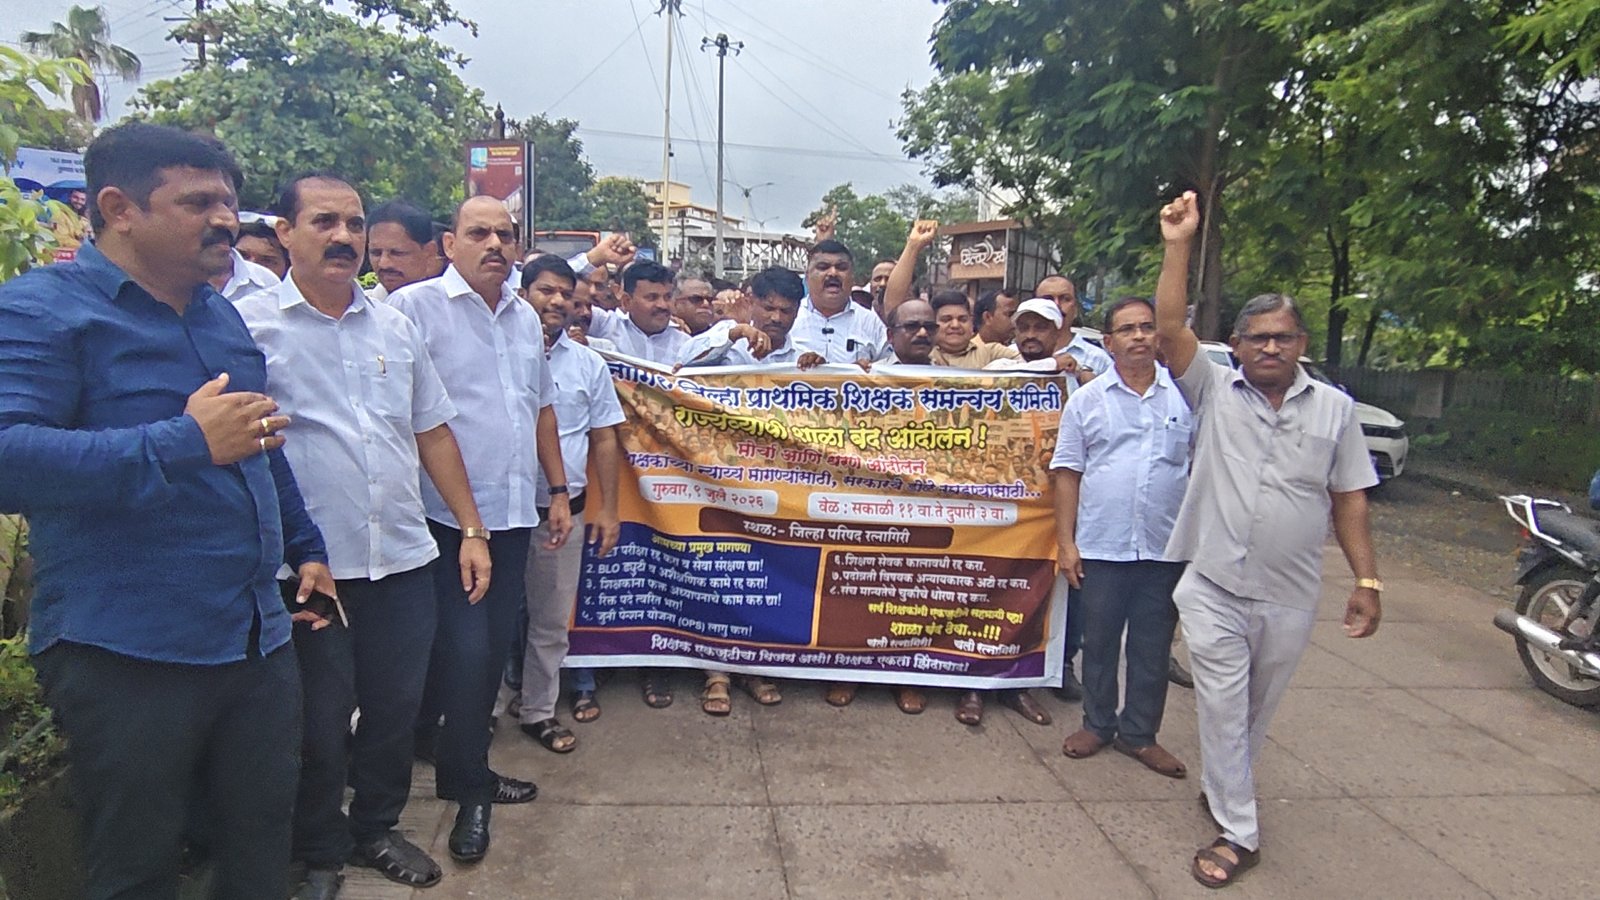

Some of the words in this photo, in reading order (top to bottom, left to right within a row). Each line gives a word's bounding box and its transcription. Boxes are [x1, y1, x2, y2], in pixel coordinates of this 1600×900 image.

[748, 382, 836, 410] प्राथमिक
[843, 381, 913, 412] शिक्षक
[919, 388, 1003, 411] समन्वय
[1009, 383, 1060, 411] समिती
[674, 404, 789, 440] राज्यव्यापी
[792, 426, 845, 447] शाळा
[850, 421, 881, 449] बंद
[886, 421, 973, 449] आंदोलन
[738, 441, 776, 459] मोर्चा
[783, 448, 821, 465] आणि
[866, 455, 926, 474] आंदोलन
[731, 493, 764, 510] २०२६
[818, 497, 839, 513] वेळ
[851, 500, 894, 516] सकाळी
[898, 502, 914, 519] ११
[946, 502, 976, 523] दुपारी
[980, 506, 988, 521] ३
[789, 521, 825, 541] जिल्हा
[827, 524, 862, 542] परिषद
[865, 526, 911, 544] रत्नागिरी
[598, 563, 620, 574] BLO
[621, 542, 648, 557] परीक्षा
[692, 556, 712, 571] सेवा
[714, 556, 745, 572] संरक्षण
[721, 594, 743, 606] काम
[678, 617, 705, 632] (OPS)
[890, 621, 923, 636] शाळा
